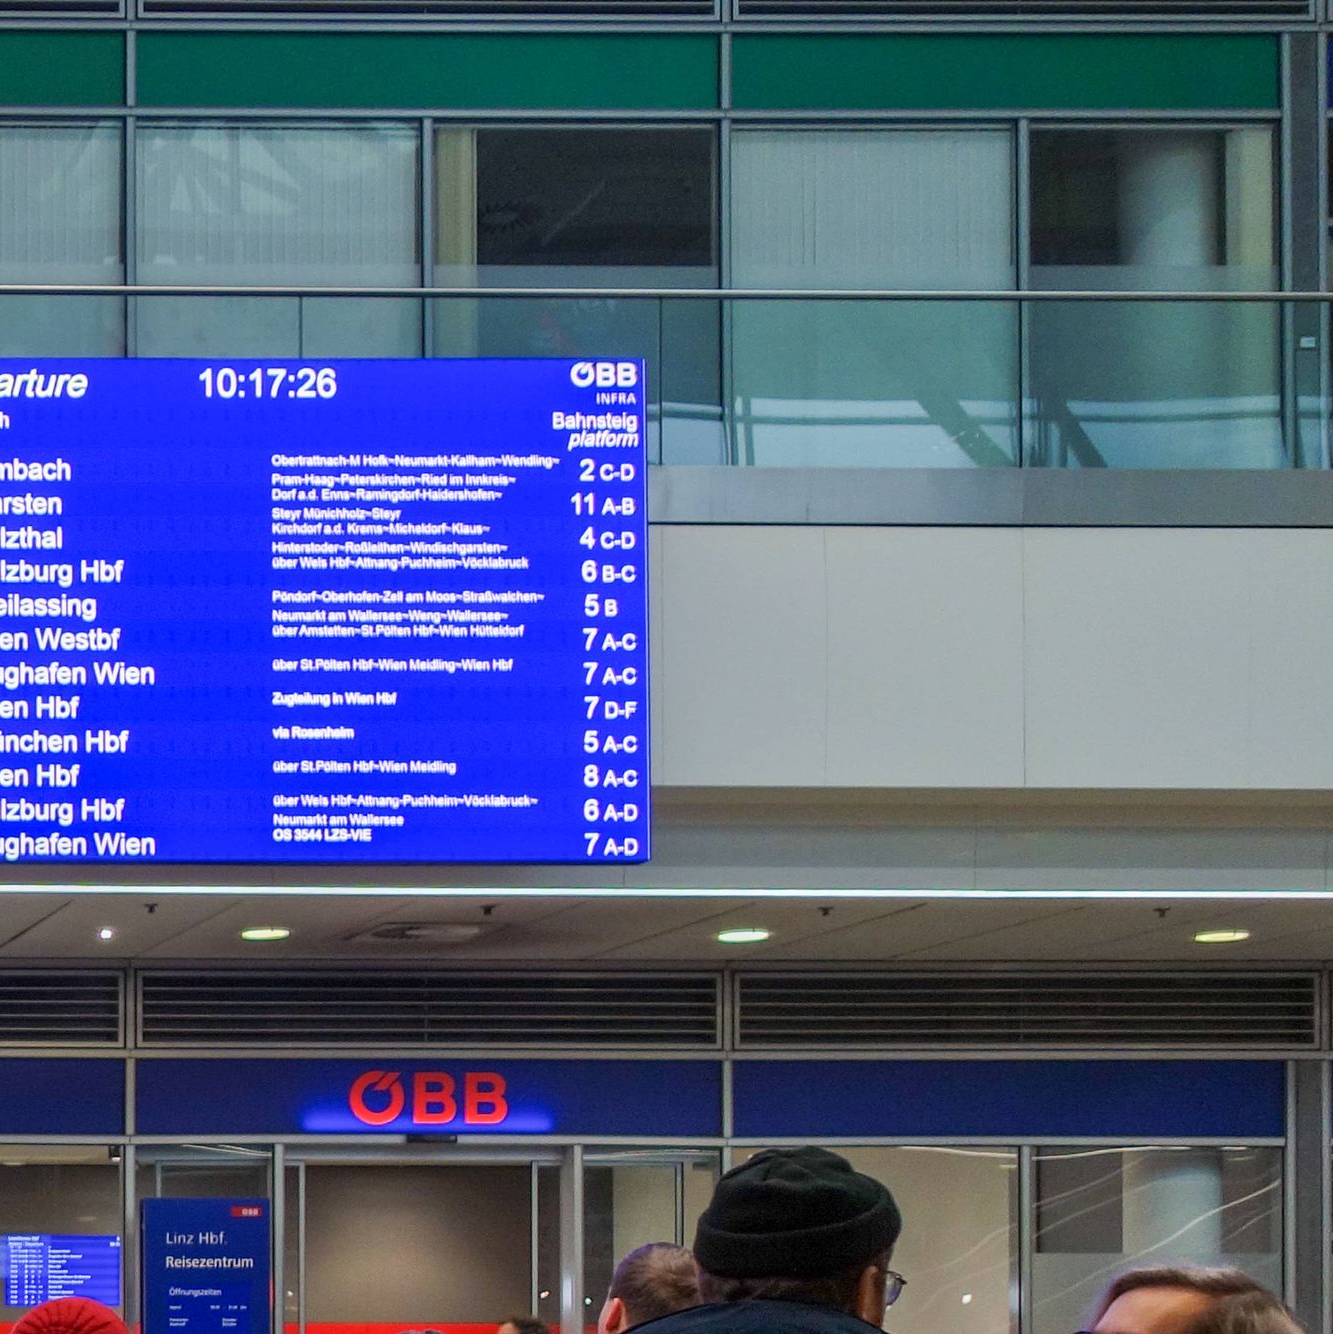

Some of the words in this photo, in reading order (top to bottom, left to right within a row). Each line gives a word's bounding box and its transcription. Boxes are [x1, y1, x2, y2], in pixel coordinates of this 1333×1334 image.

[199, 368, 336, 398] 10:17:26
[571, 362, 637, 387] ÖBB
[597, 393, 636, 404] INFRA
[553, 412, 637, 431] Bahnsteig
[568, 429, 638, 451] platform
[580, 458, 594, 481] 2
[600, 464, 634, 481] C-D
[86, 730, 129, 753] Hbf
[584, 730, 598, 753] 5
[603, 736, 637, 753] A-C
[94, 833, 155, 855] Wien
[585, 833, 599, 856] 7
[604, 838, 638, 856] A-D
[350, 1070, 508, 1126] ÖBB
[166, 1233, 193, 1244] Linz
[199, 1231, 226, 1244] Hbf.
[166, 1256, 253, 1268] Reisezentrum
[169, 1287, 221, 1297] Öffnungszeiten
